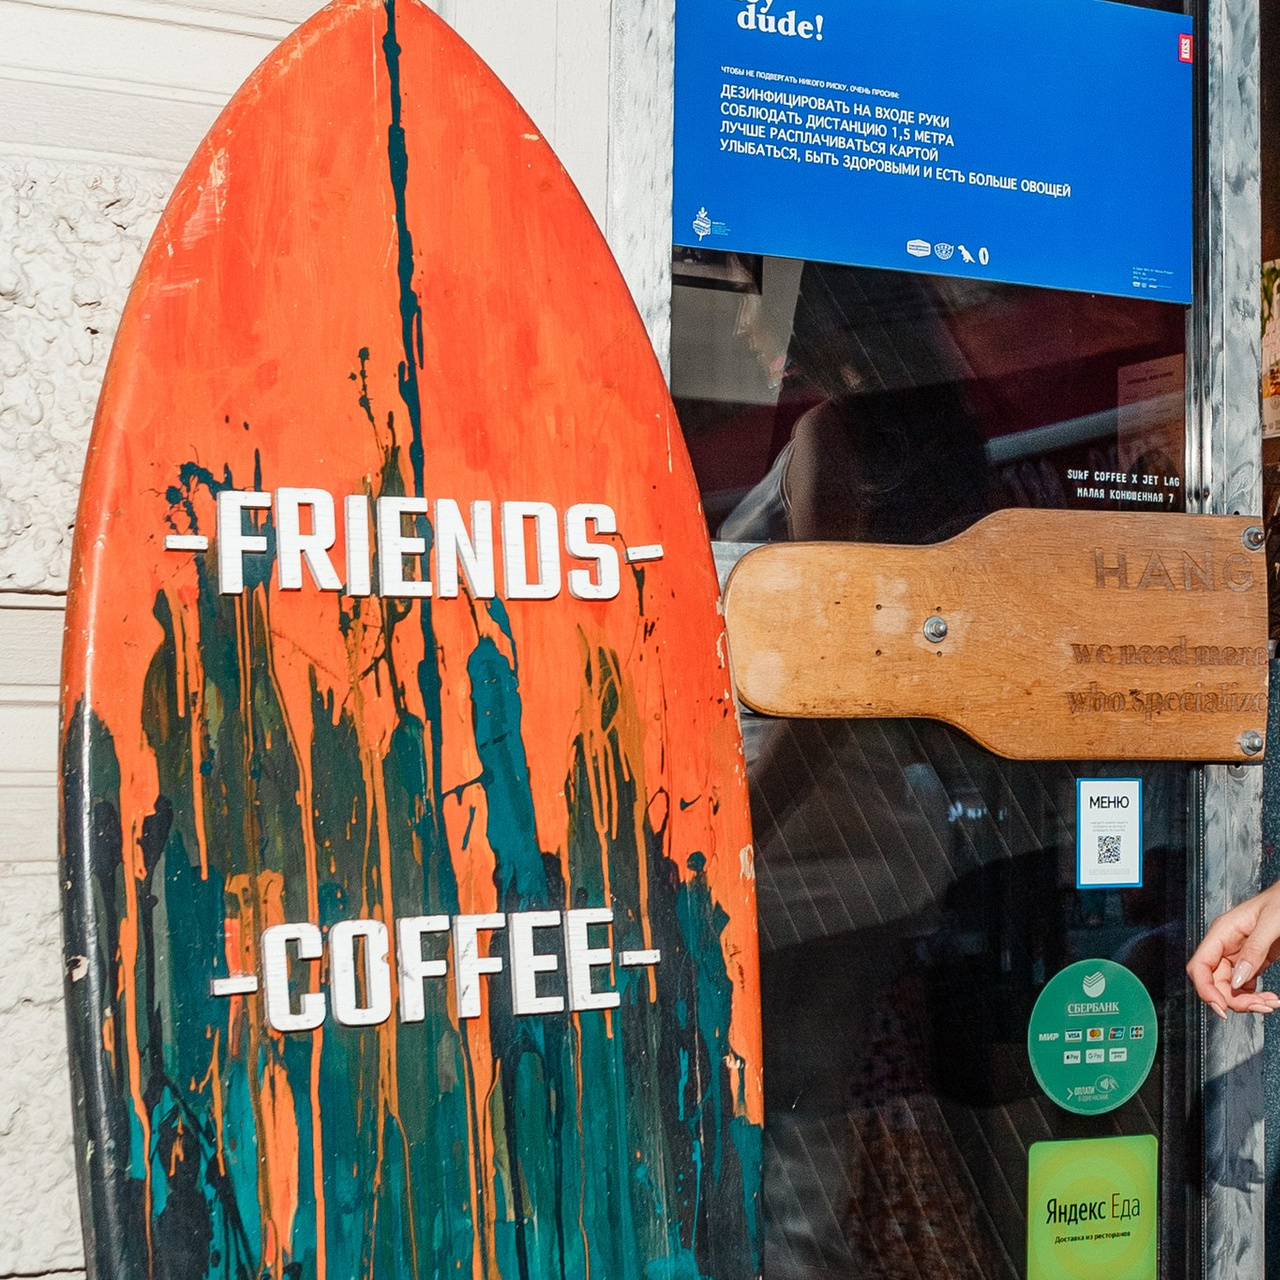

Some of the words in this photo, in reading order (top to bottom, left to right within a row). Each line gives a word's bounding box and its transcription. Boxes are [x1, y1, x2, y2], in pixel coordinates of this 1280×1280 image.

[737, 3, 824, 41] dude!
[720, 65, 745, 76] ЧТОБЫ
[746, 69, 755, 78] НЕ
[756, 71, 798, 84] ПОДВЕРГАТЬ
[799, 77, 825, 88] НИКОГО
[850, 85, 871, 95] ОЧЕНЬ
[720, 84, 850, 114] ДЕЗИНФИЦИРОВАТЬ
[853, 102, 872, 118] НА
[875, 106, 915, 125] ВХОДЕ
[918, 112, 950, 129] РУКИ
[720, 101, 803, 125] СОБЛЮДАТЬ
[805, 114, 888, 138] ДИСТАНЦИЮ
[891, 126, 911, 142] 1,5
[914, 129, 955, 147] МЕТРА
[720, 120, 766, 138] ЛУЧШЕ
[769, 127, 886, 154] РАСПЛАЧИВАТЬСЯ
[889, 143, 939, 162] КАРТОЙ
[720, 138, 801, 163] УЛЫБАТЬСЯ,
[804, 150, 839, 166] БЫТЬ
[842, 155, 921, 178] ЗДОРОВЫМИ
[923, 165, 933, 179] И
[935, 167, 966, 184] ЕСТЬ
[968, 172, 1017, 190] БОЛЬШЕ
[1020, 179, 1072, 198] ОВОЩЕЙ
[1094, 471, 1127, 483] COFFEE
[1131, 474, 1138, 484] X
[1142, 475, 1159, 485] JET
[1164, 476, 1180, 487] LAG
[1077, 487, 1105, 499] МАЛАЯ
[1109, 489, 1164, 503] КОНЮШЕННАЯ
[1168, 493, 1174, 504] 7
[1094, 547, 1255, 593] HANG
[1071, 642, 1113, 665] we
[1119, 635, 1188, 666] need
[1193, 645, 1268, 667] more
[1065, 681, 1126, 715] who
[1130, 682, 1268, 727] specialize
[1089, 795, 1130, 809] МЕНЮ
[1067, 1002, 1120, 1014] СБЕРБАНК
[1038, 1032, 1059, 1042] МИР
[1046, 1198, 1106, 1226] Яндекс
[1111, 1193, 1140, 1221] Еда
[1054, 1236, 1085, 1245] Доставка
[1094, 1230, 1131, 1242] ресторанов
